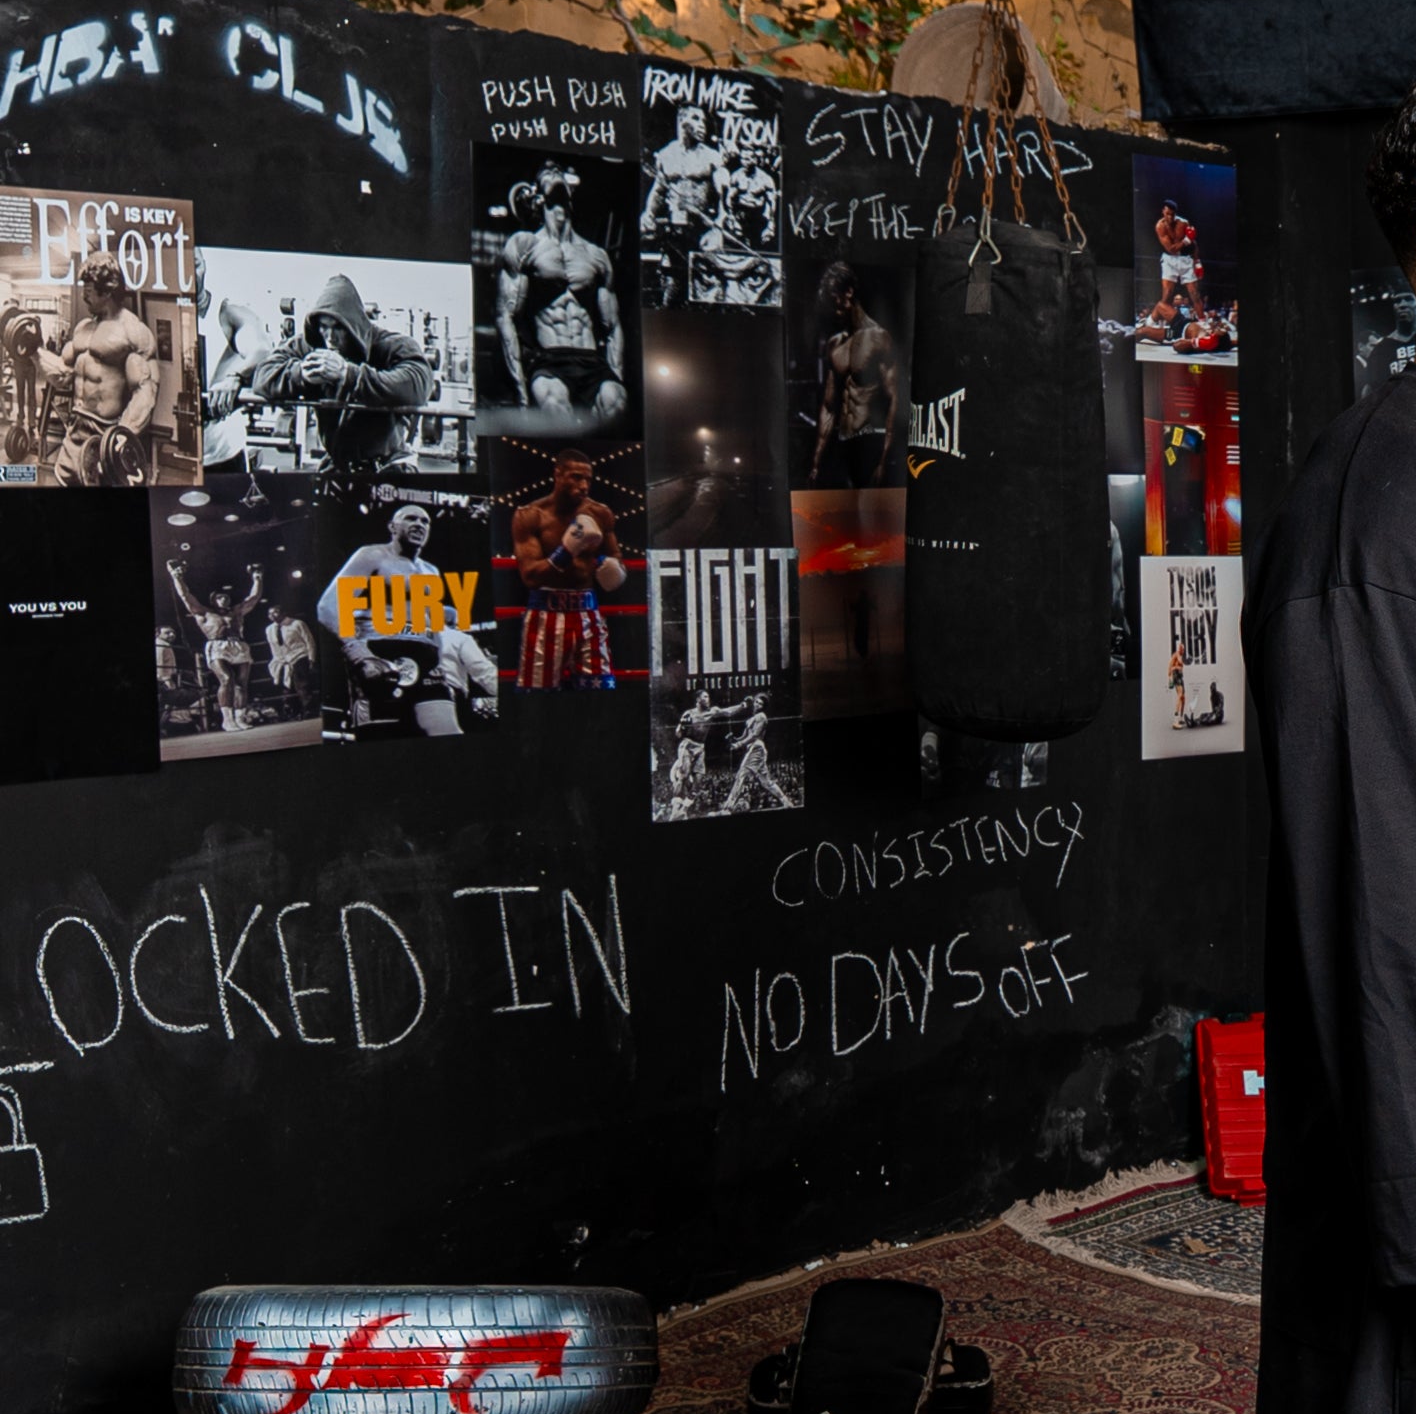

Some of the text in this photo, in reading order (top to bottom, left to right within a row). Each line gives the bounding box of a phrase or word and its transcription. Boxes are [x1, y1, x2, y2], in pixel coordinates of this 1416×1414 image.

[481, 75, 627, 114] PUSH PUSH
[642, 65, 759, 113] IRON MIKE
[491, 117, 617, 148] PUSH PUSH
[716, 110, 779, 150] TYSON
[805, 103, 1093, 181] STAY HARD
[125, 206, 176, 225] IS KEY
[788, 195, 860, 240] KEEP
[862, 193, 925, 239] THE
[32, 198, 193, 293] Effort
[438, 491, 470, 508] PPV
[9, 600, 87, 614] YOU VS YOU
[336, 571, 480, 639] FURY
[1167, 566, 1217, 609] TYSON
[646, 547, 799, 677] FIGHT
[1169, 608, 1218, 666] FURY
[772, 801, 1085, 908] CONSISTENCY
[0, 873, 632, 1074] OCKED IN
[721, 932, 1090, 1094] NO DAYS OFF
